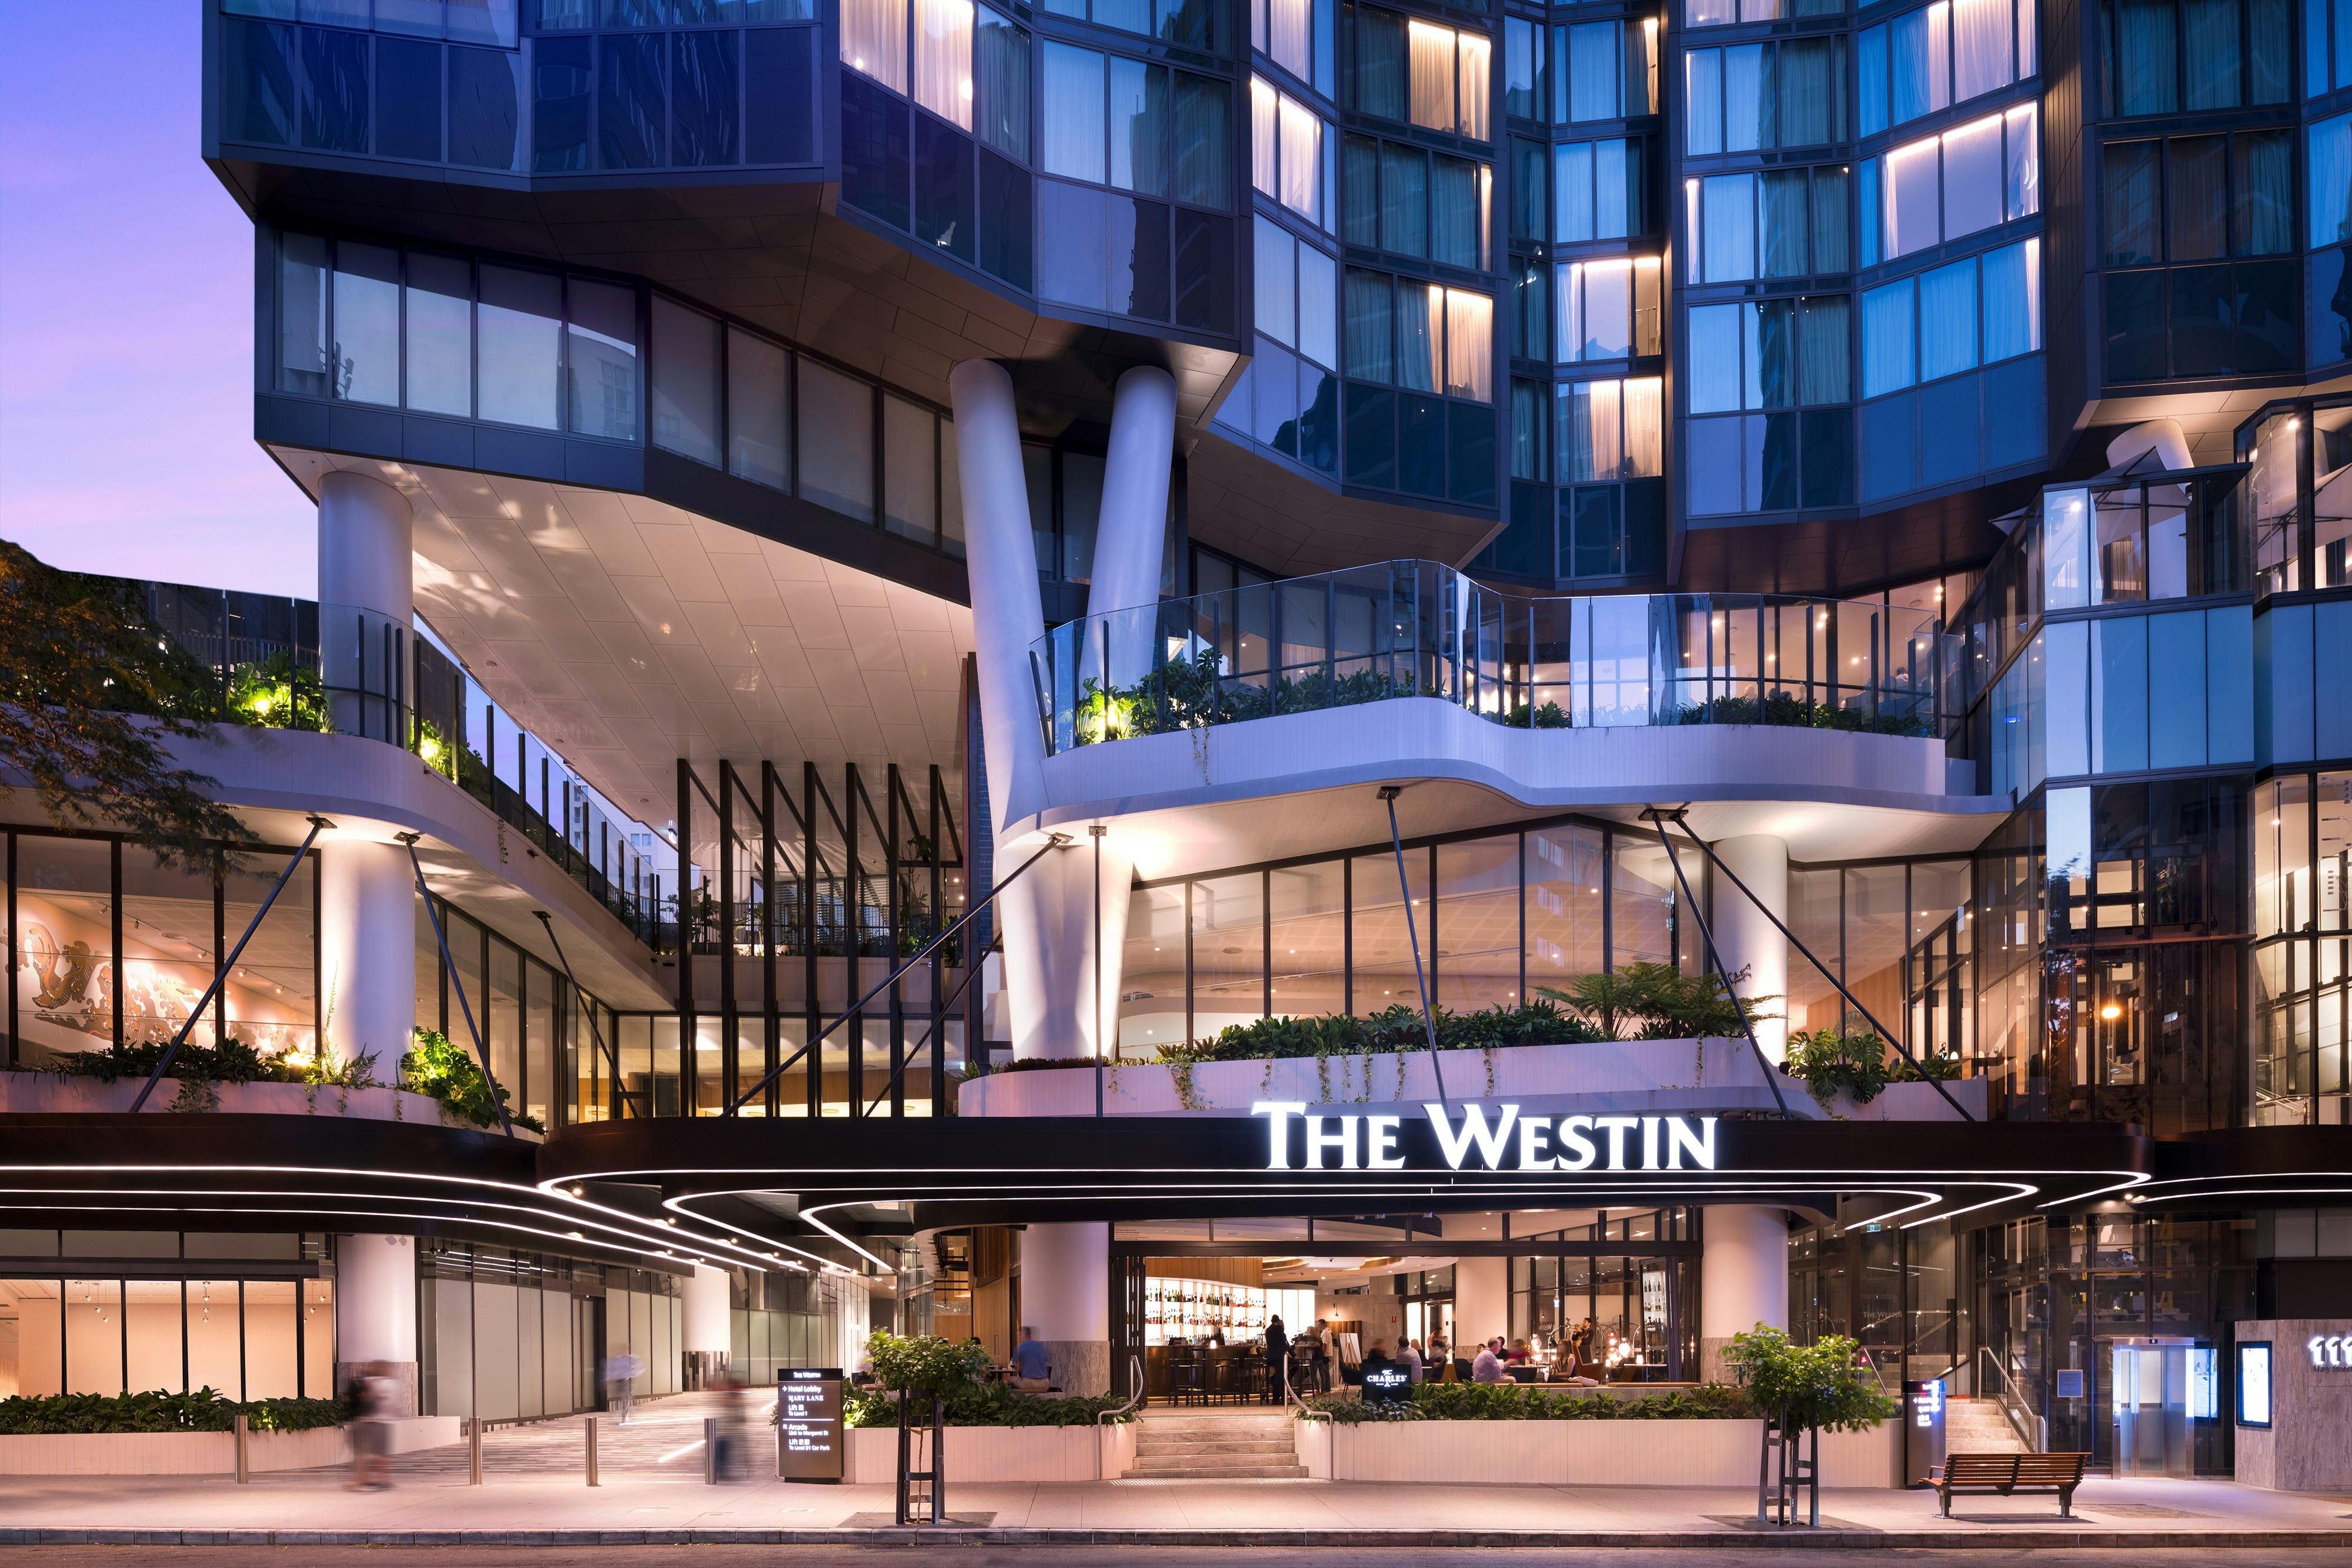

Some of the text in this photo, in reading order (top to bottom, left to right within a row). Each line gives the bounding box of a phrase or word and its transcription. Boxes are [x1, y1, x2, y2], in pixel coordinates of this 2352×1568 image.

[1251, 1101, 1718, 1171] THE WESTIN
[804, 1385, 821, 1393] Lobby
